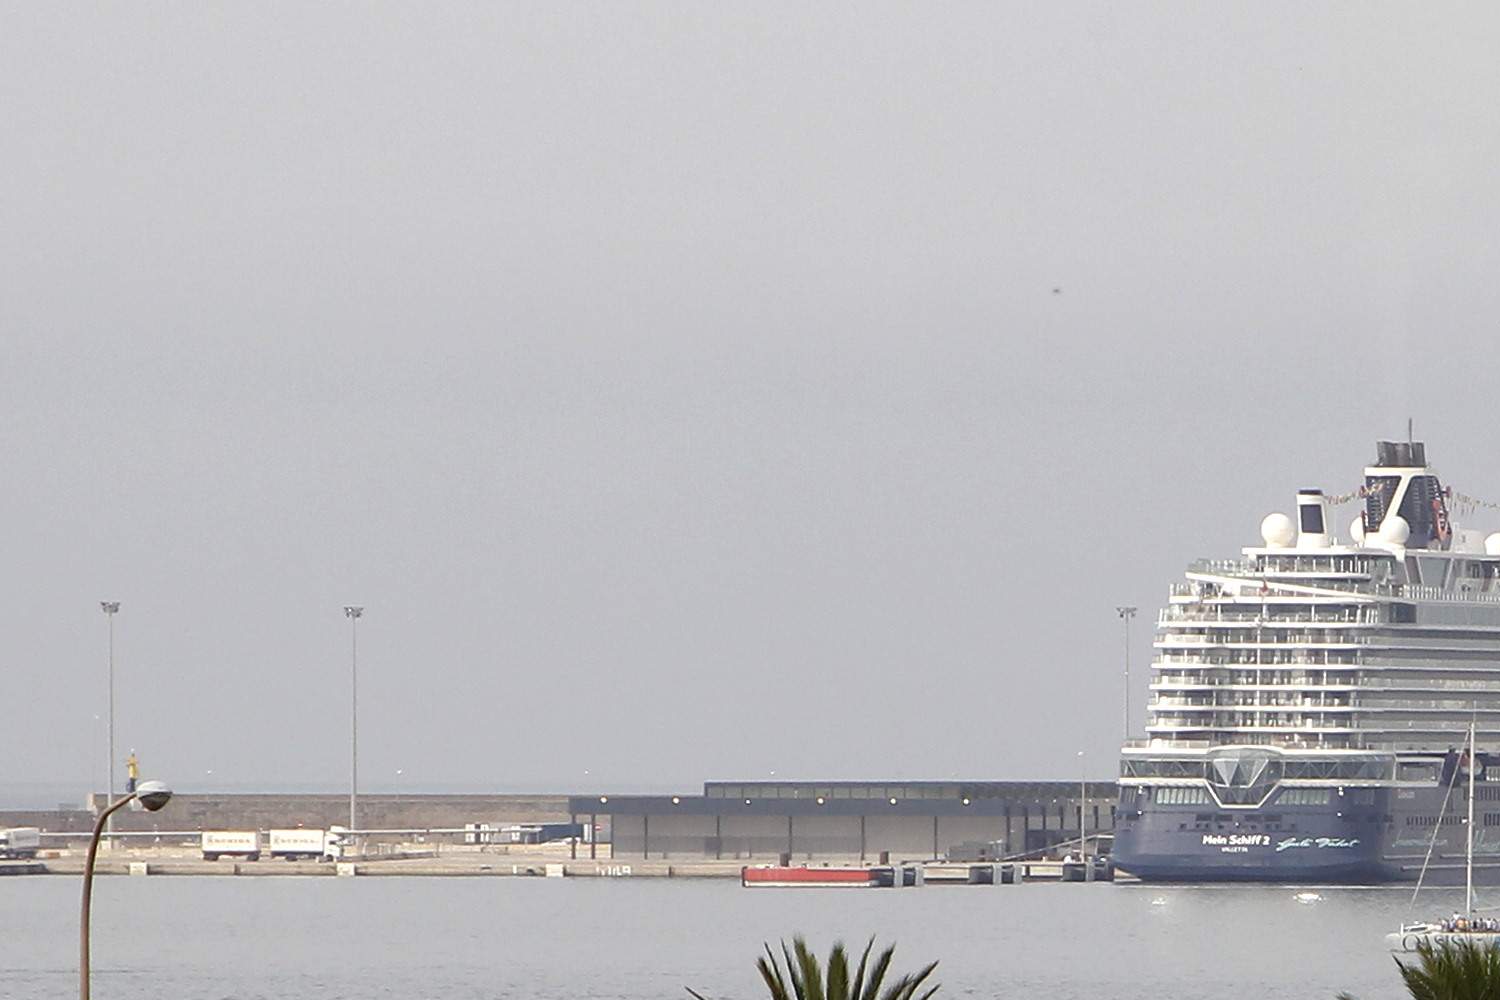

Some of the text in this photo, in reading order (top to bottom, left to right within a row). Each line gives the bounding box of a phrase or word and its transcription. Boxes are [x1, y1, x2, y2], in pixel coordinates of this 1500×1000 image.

[1202, 834, 1271, 845] Mein Schiff 2
